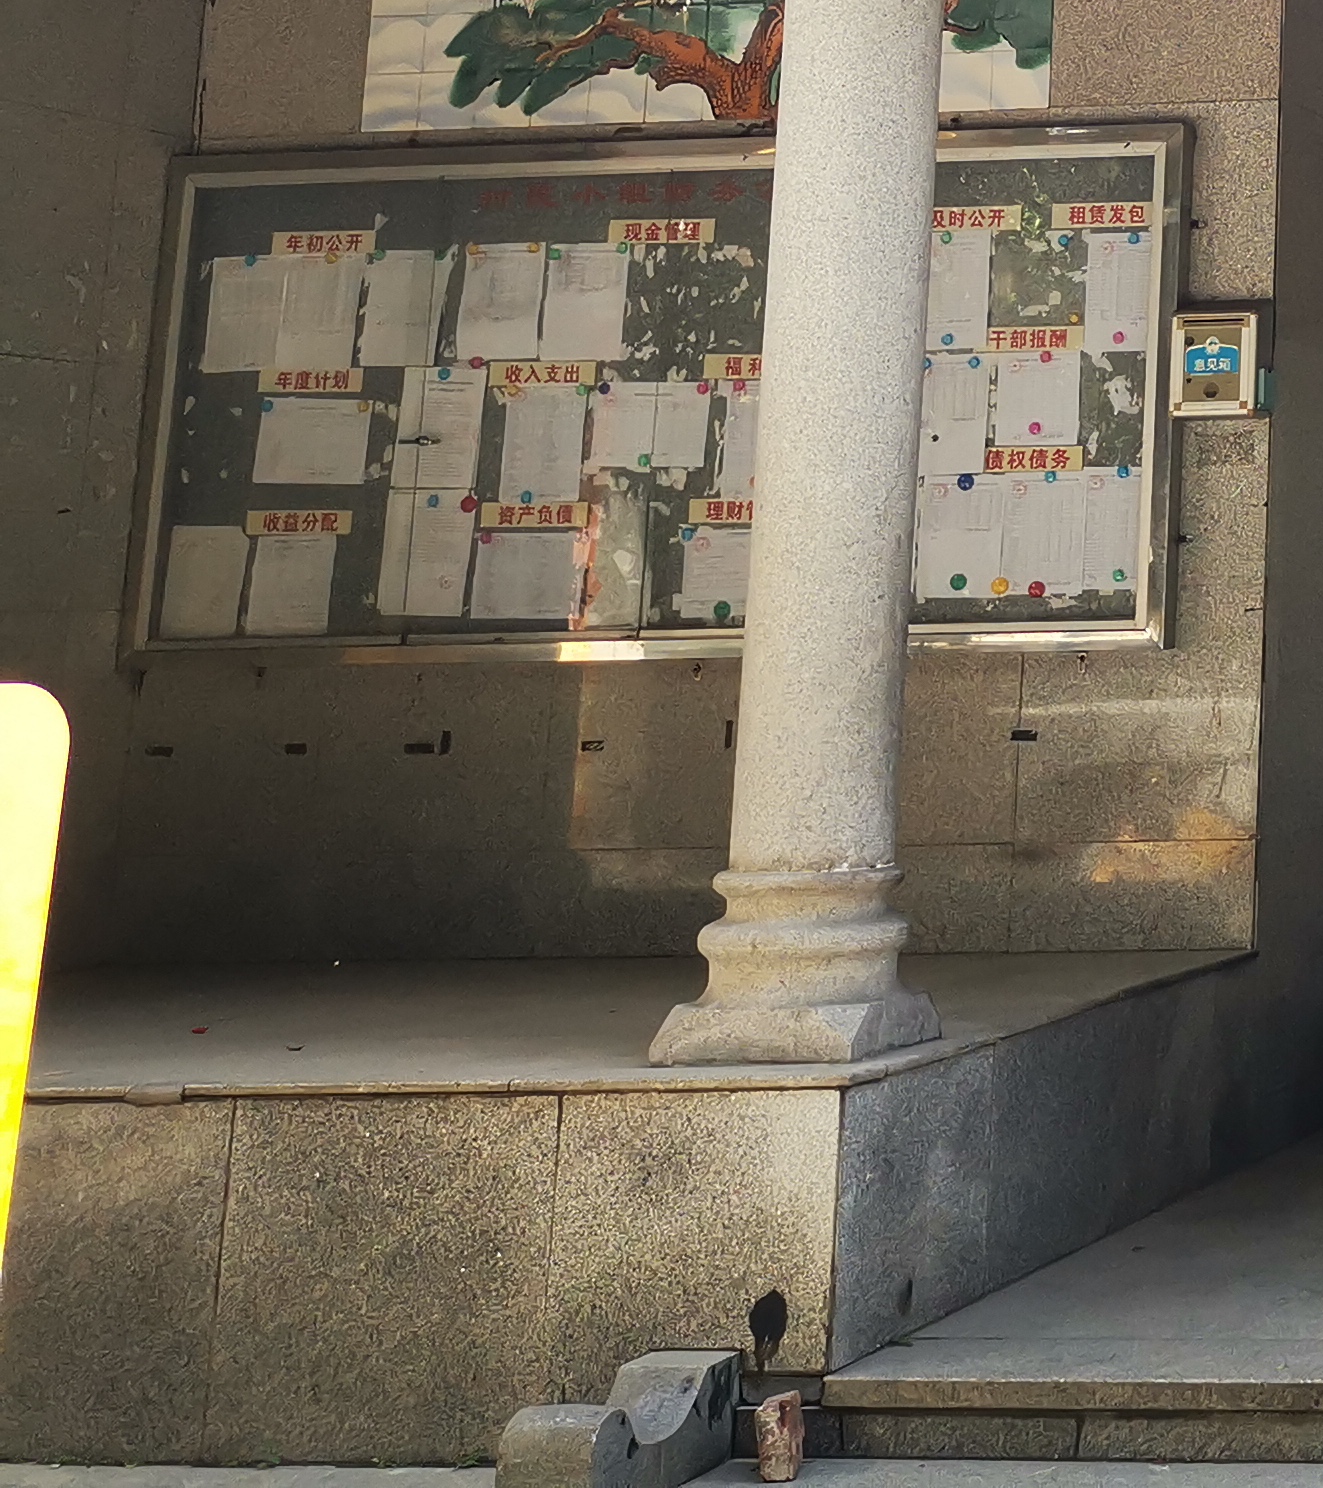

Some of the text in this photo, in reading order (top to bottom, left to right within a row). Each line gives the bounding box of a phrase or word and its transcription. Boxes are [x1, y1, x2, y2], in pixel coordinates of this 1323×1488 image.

[933, 208, 1006, 229] 及时公开
[1068, 205, 1145, 225] 租赁发包
[624, 222, 701, 242] 现金管理
[286, 234, 363, 254] 年初公开
[989, 328, 1068, 350] 干部报酬
[1193, 357, 1232, 372] 意见箱
[275, 369, 350, 391] 年度计划
[505, 365, 580, 385] 收入支出
[985, 449, 1071, 471] 债权债务
[263, 513, 338, 533] 收益分配
